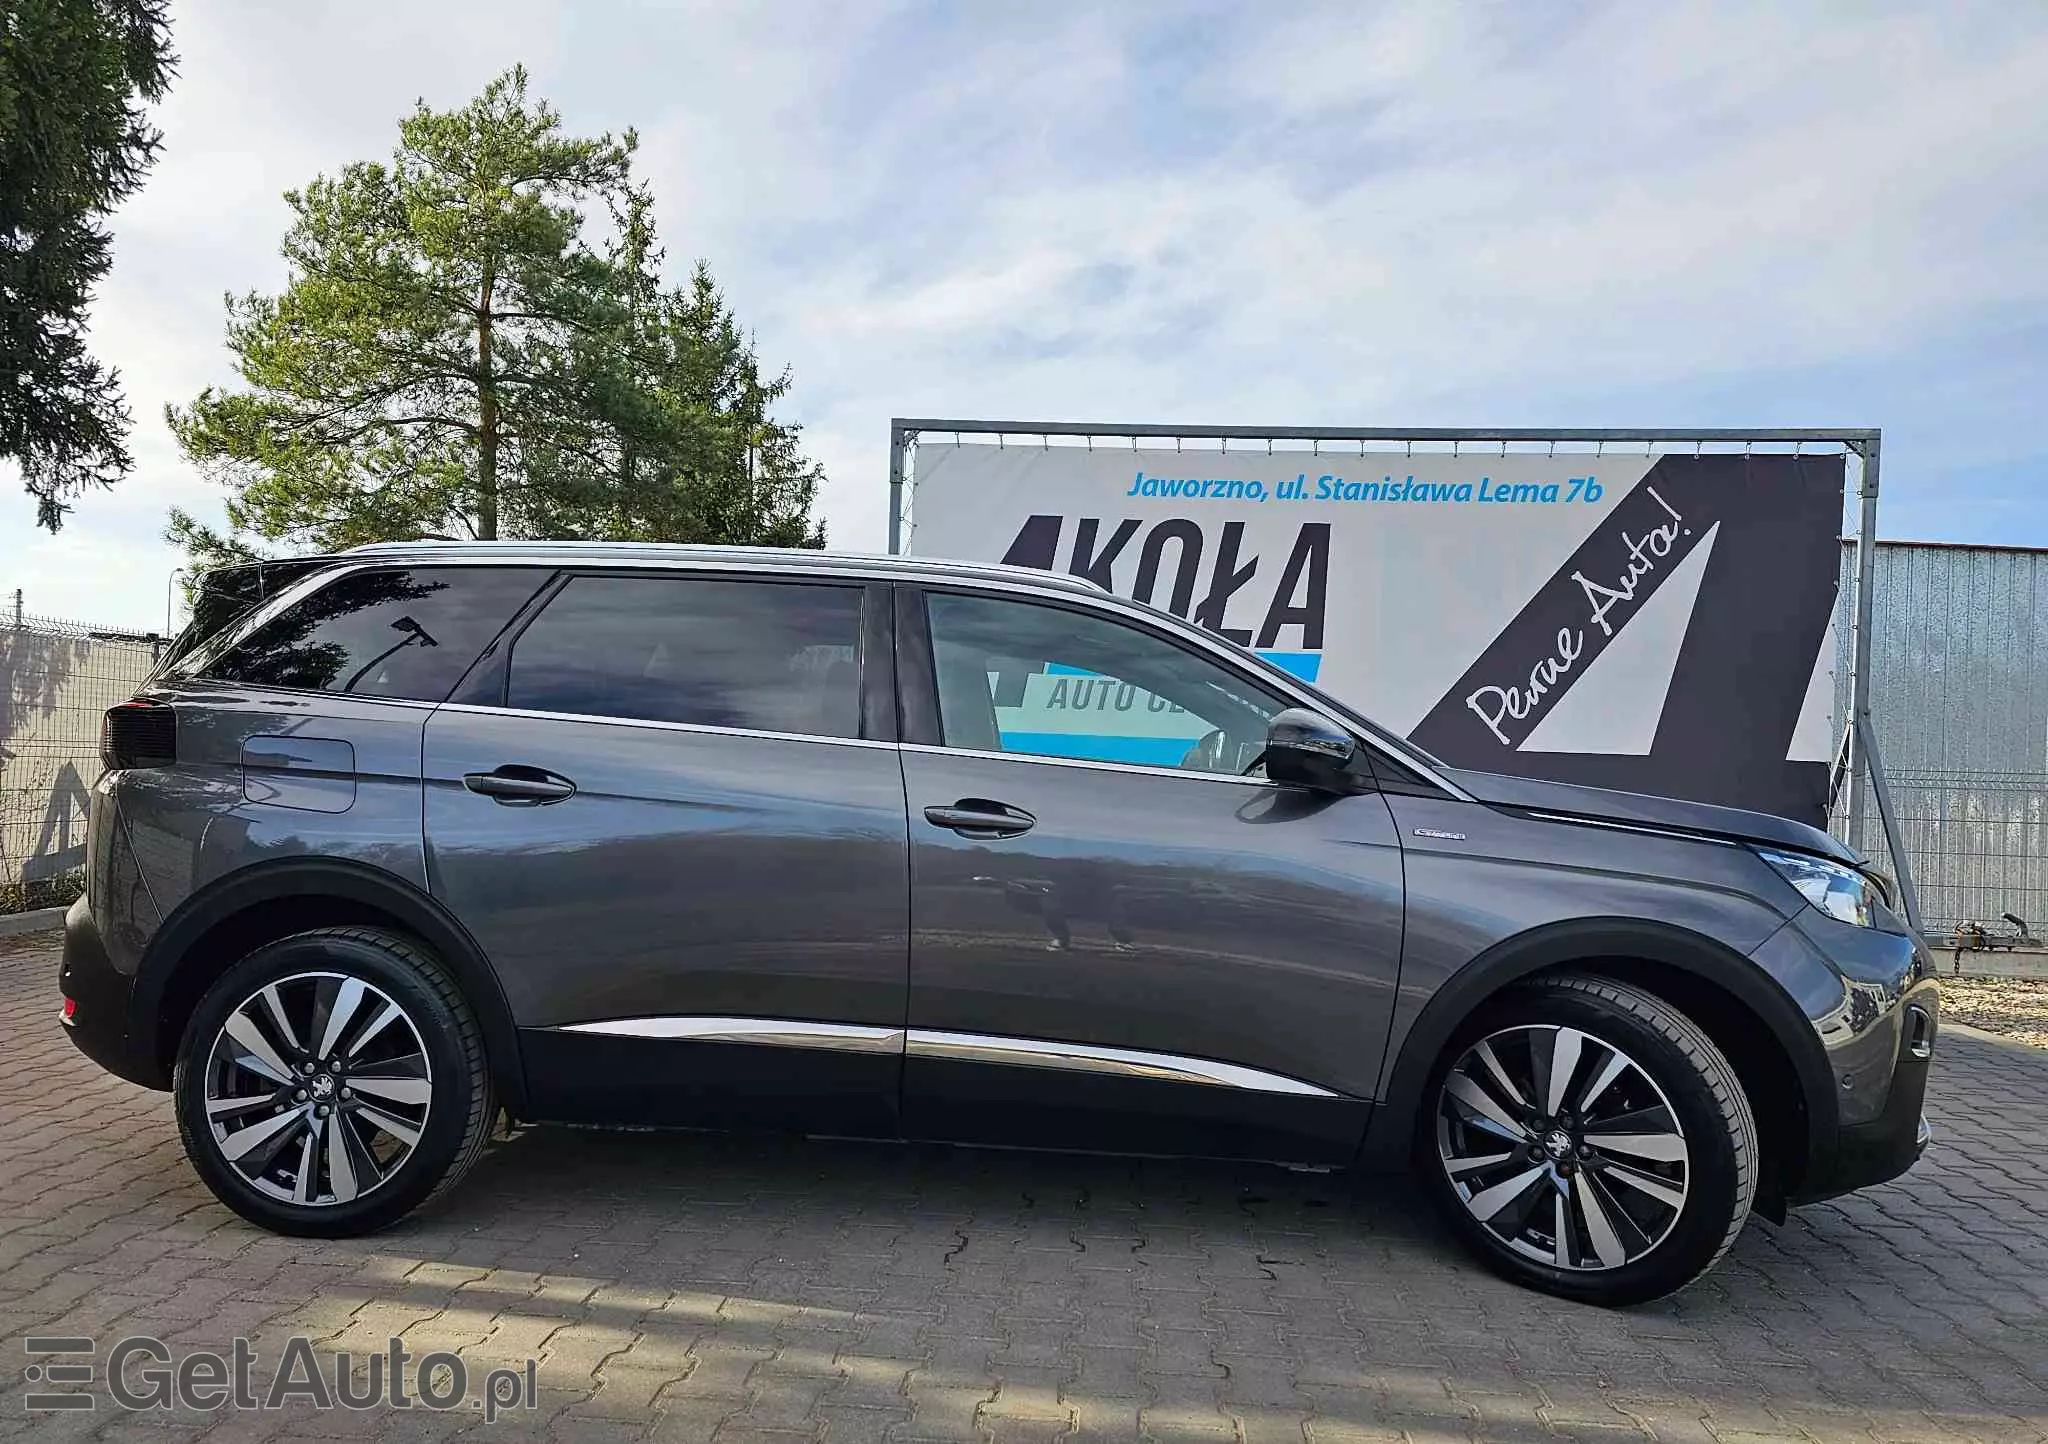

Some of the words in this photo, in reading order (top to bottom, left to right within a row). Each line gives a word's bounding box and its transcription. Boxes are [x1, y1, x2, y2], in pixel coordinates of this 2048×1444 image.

[1127, 472, 1268, 502] Jaworzno,
[1275, 474, 1308, 500] ul.
[1315, 475, 1473, 502] Stanisława
[1478, 477, 1559, 503] Lema
[1566, 476, 1604, 503] 7b
[1571, 486, 1692, 636] Auta!
[1046, 678, 1136, 712] AUTO
